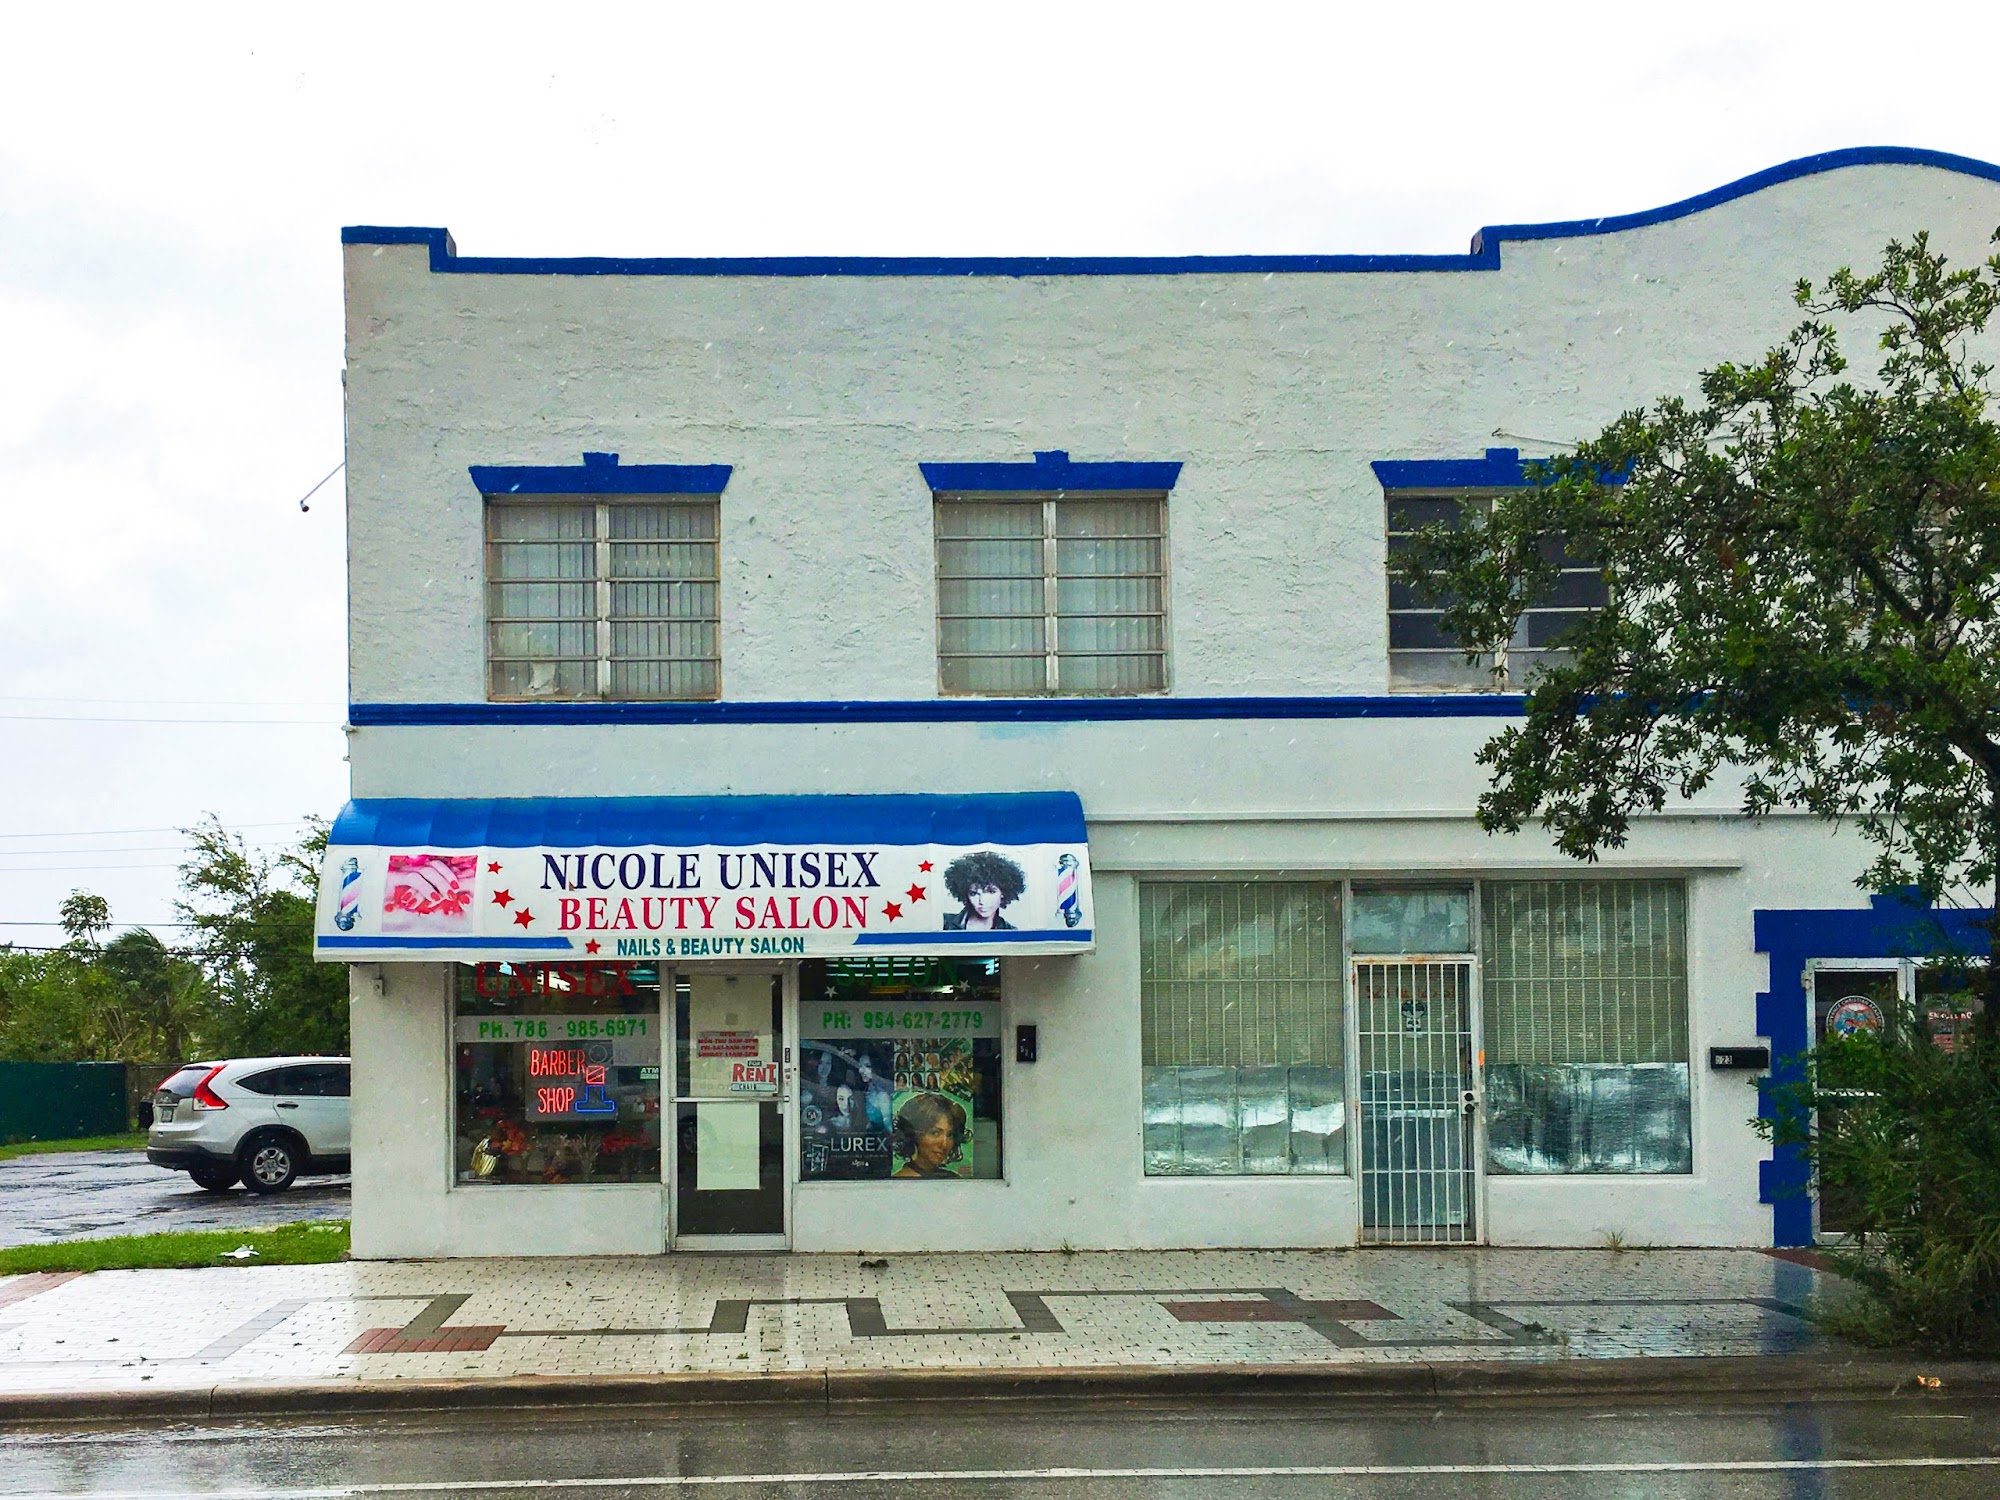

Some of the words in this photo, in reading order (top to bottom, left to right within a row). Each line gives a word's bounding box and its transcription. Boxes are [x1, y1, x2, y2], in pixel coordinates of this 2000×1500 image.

[540, 852, 700, 890] NICOLE
[717, 852, 881, 888] UNISEX
[558, 896, 720, 930] BEAUTY
[735, 895, 869, 929] SALON
[617, 938, 663, 956] NAILS
[666, 938, 676, 956] &
[680, 937, 745, 956] BEAUTY
[750, 936, 805, 955] SALON
[475, 961, 637, 997] UNISEX
[836, 957, 958, 986] SALON
[822, 1011, 851, 1029] PH:
[863, 1011, 983, 1029] 954-627-2779
[530, 1049, 586, 1076] BARBER
[732, 1063, 777, 1083] RENT
[537, 1086, 575, 1113] SHOP
[830, 1137, 888, 1152] LUREX
